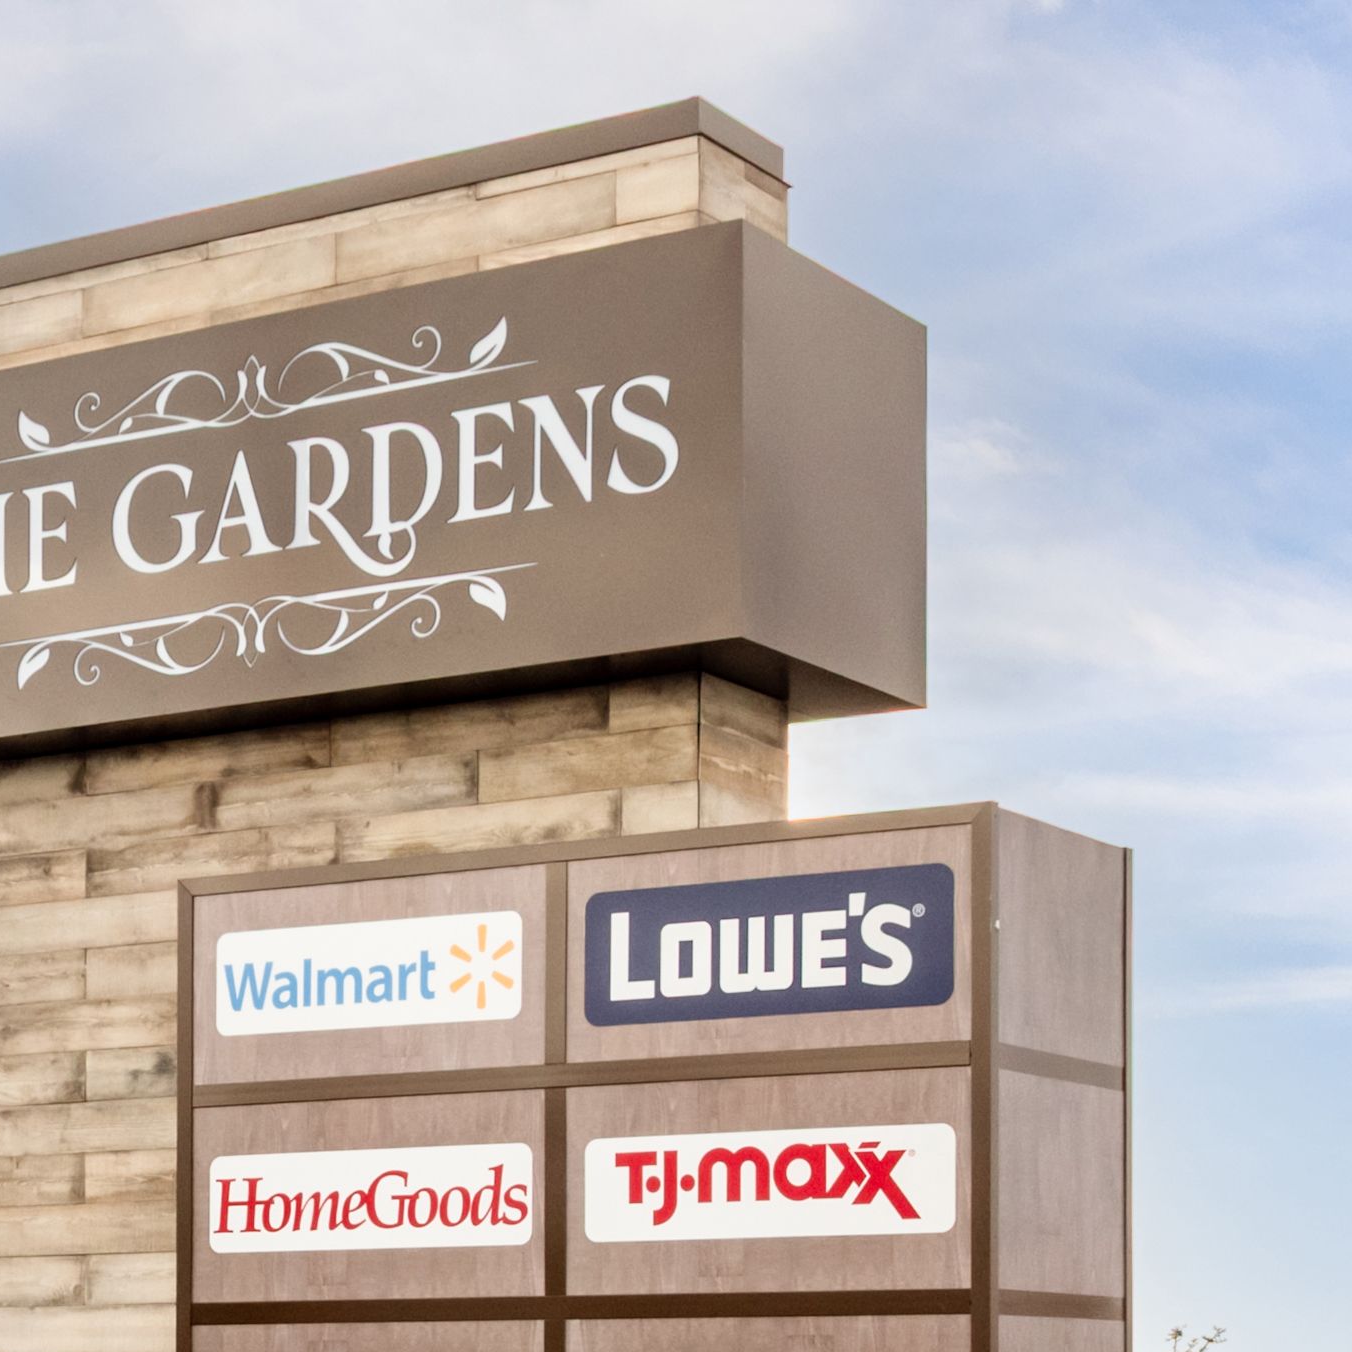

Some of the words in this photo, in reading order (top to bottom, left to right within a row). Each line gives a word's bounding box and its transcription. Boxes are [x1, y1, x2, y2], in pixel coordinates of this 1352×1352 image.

[111, 374, 681, 577] GARDENS
[224, 951, 436, 1012] Walmart
[213, 1164, 531, 1235] HomeGoods
